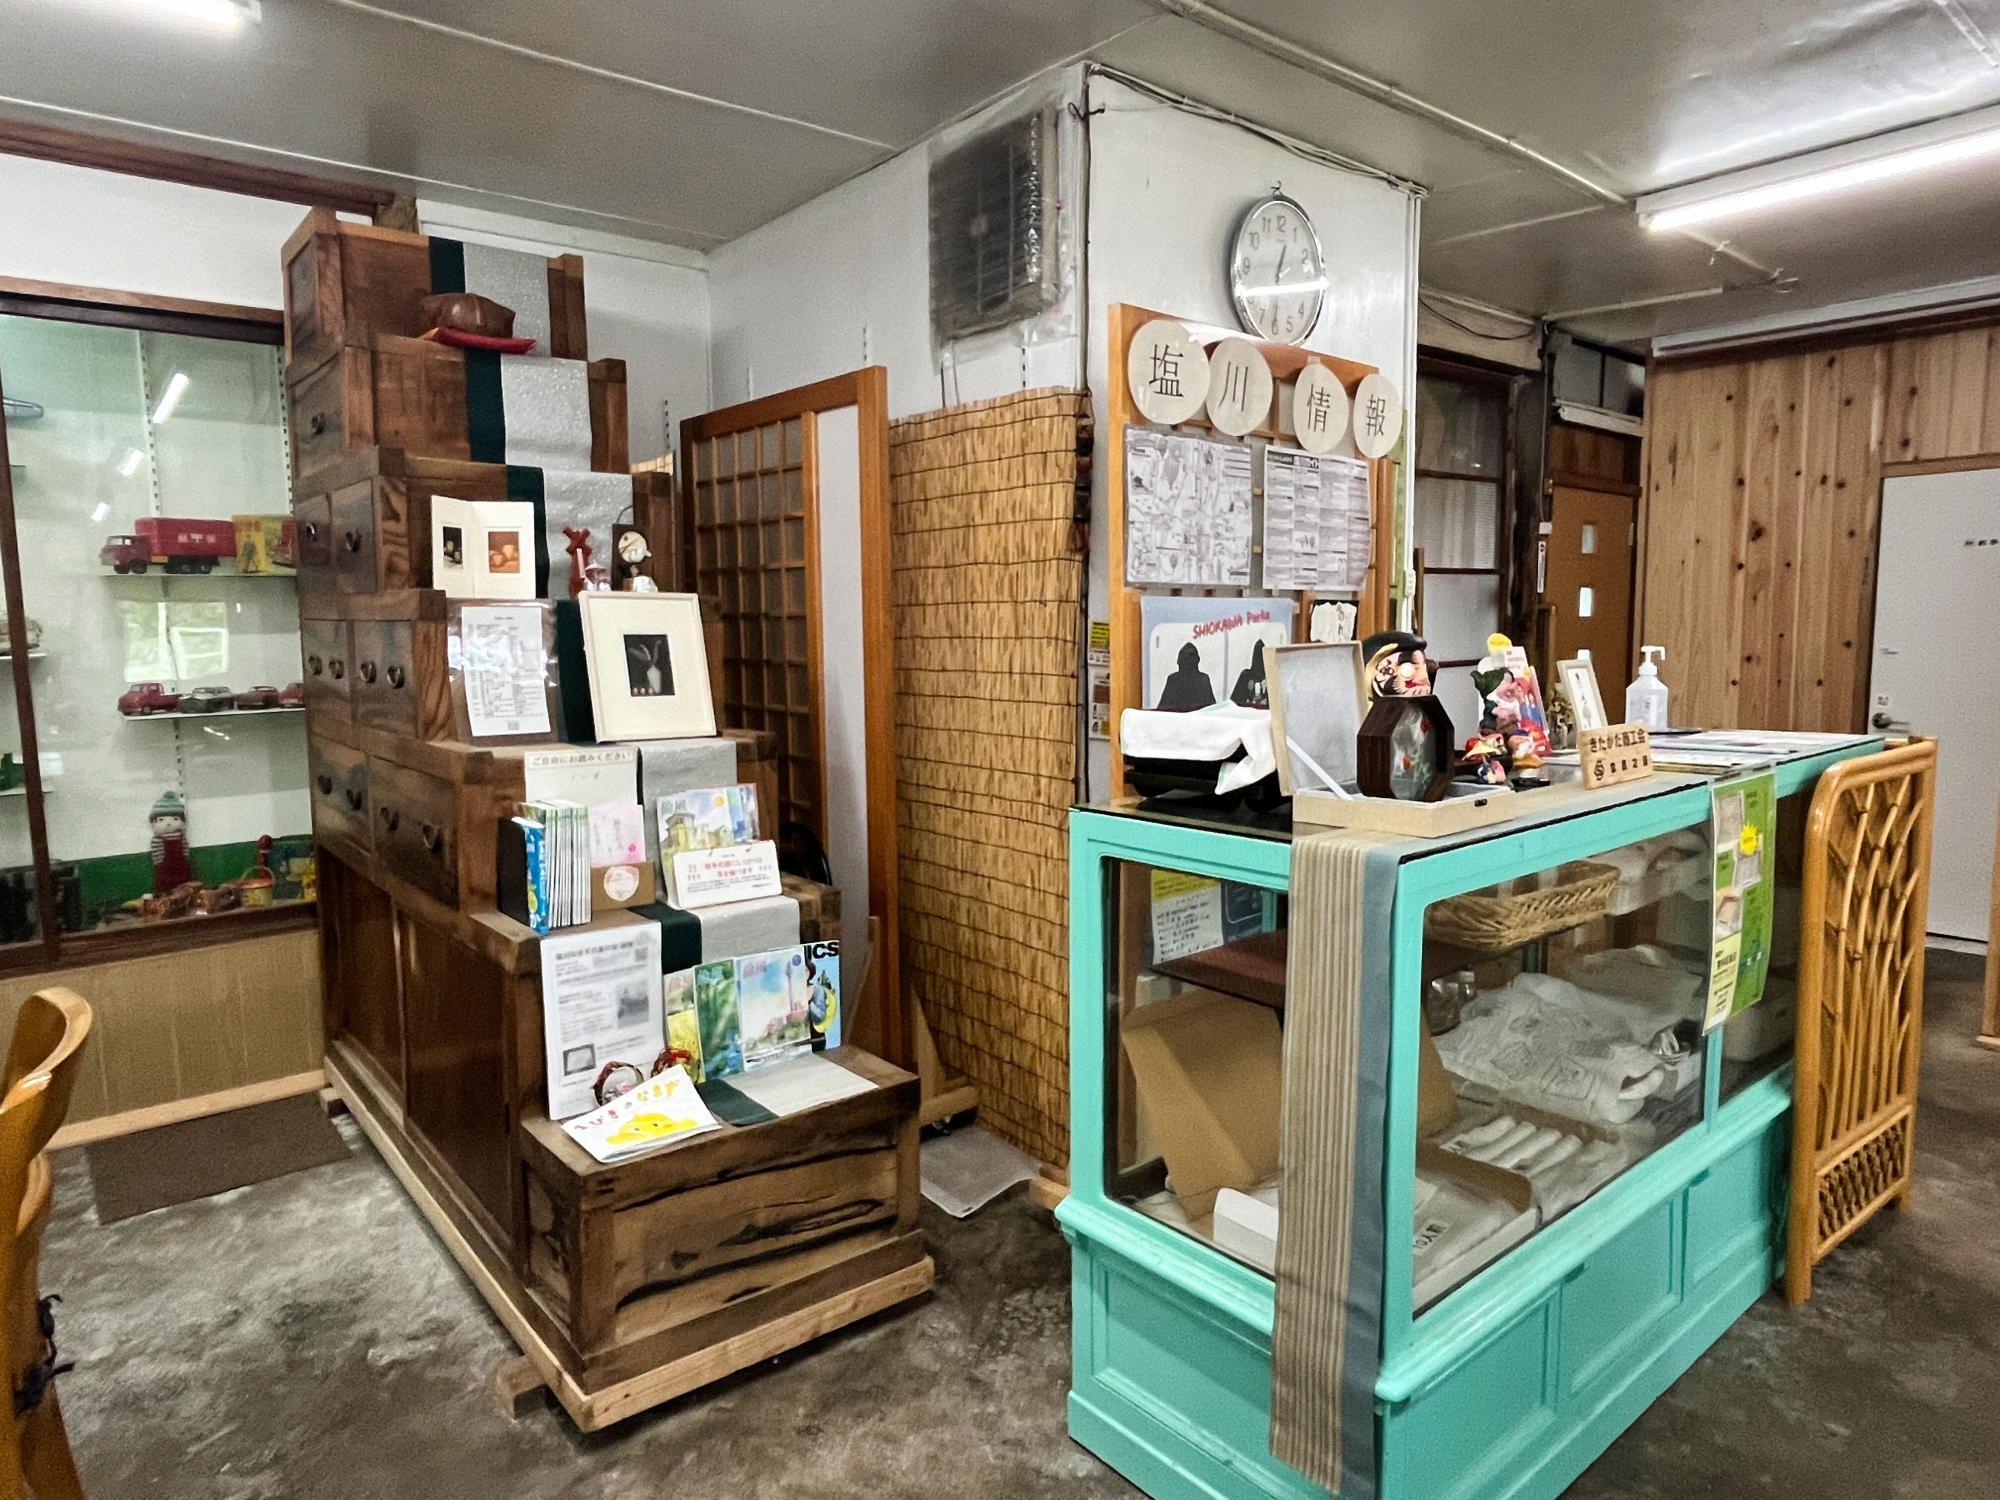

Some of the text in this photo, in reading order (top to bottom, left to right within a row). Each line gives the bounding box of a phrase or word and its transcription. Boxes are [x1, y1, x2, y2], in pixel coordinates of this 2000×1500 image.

[1262, 217, 1271, 233] 11
[1277, 215, 1286, 232] 12
[1249, 231, 1260, 250] 10
[1292, 227, 1297, 242] 1
[1301, 248, 1309, 264] 2
[1243, 256, 1250, 275] 9
[1259, 308, 1266, 325] 7
[1298, 302, 1304, 318] 4
[1271, 317, 1279, 335] 6
[1286, 316, 1293, 333] 5
[1149, 344, 1386, 437] 塩川情報
